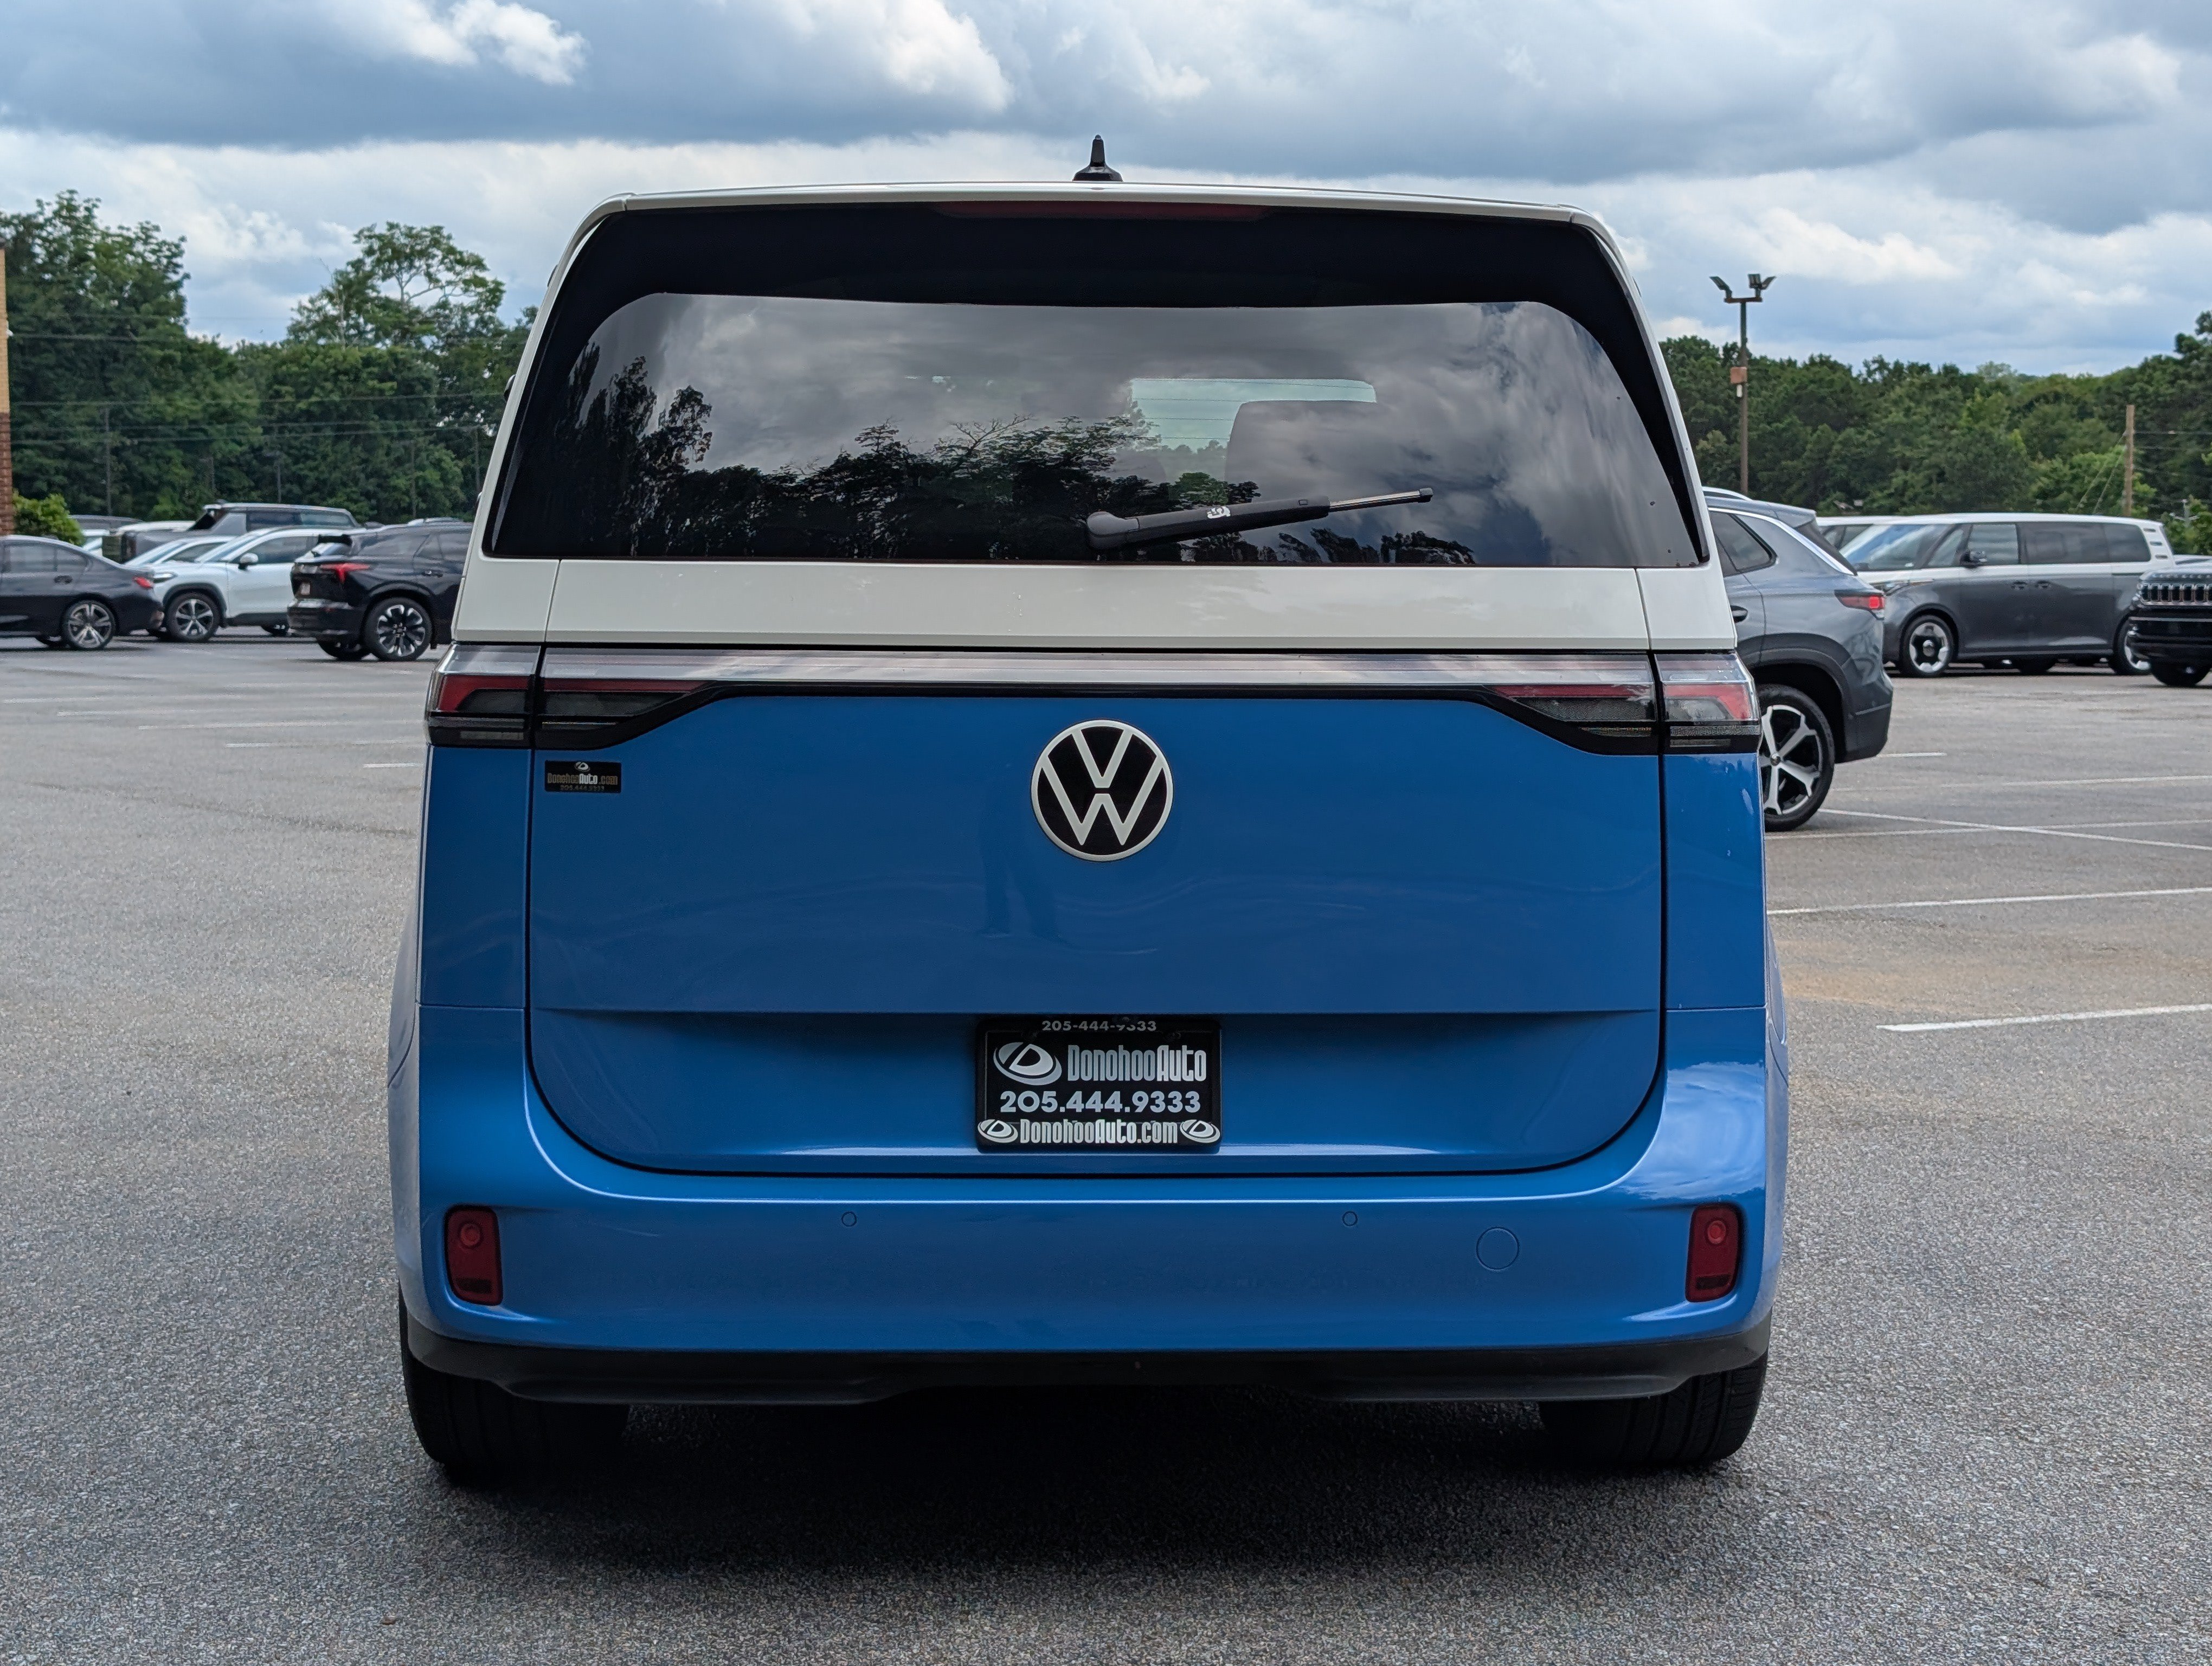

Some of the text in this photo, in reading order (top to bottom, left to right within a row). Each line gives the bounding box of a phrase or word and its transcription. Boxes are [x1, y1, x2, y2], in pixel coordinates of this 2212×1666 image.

[1067, 1045, 1207, 1082] DonohooAuto
[1000, 1091, 1201, 1113] 205.444.9333
[1020, 1118, 1178, 1144] DonohooAuto.com
